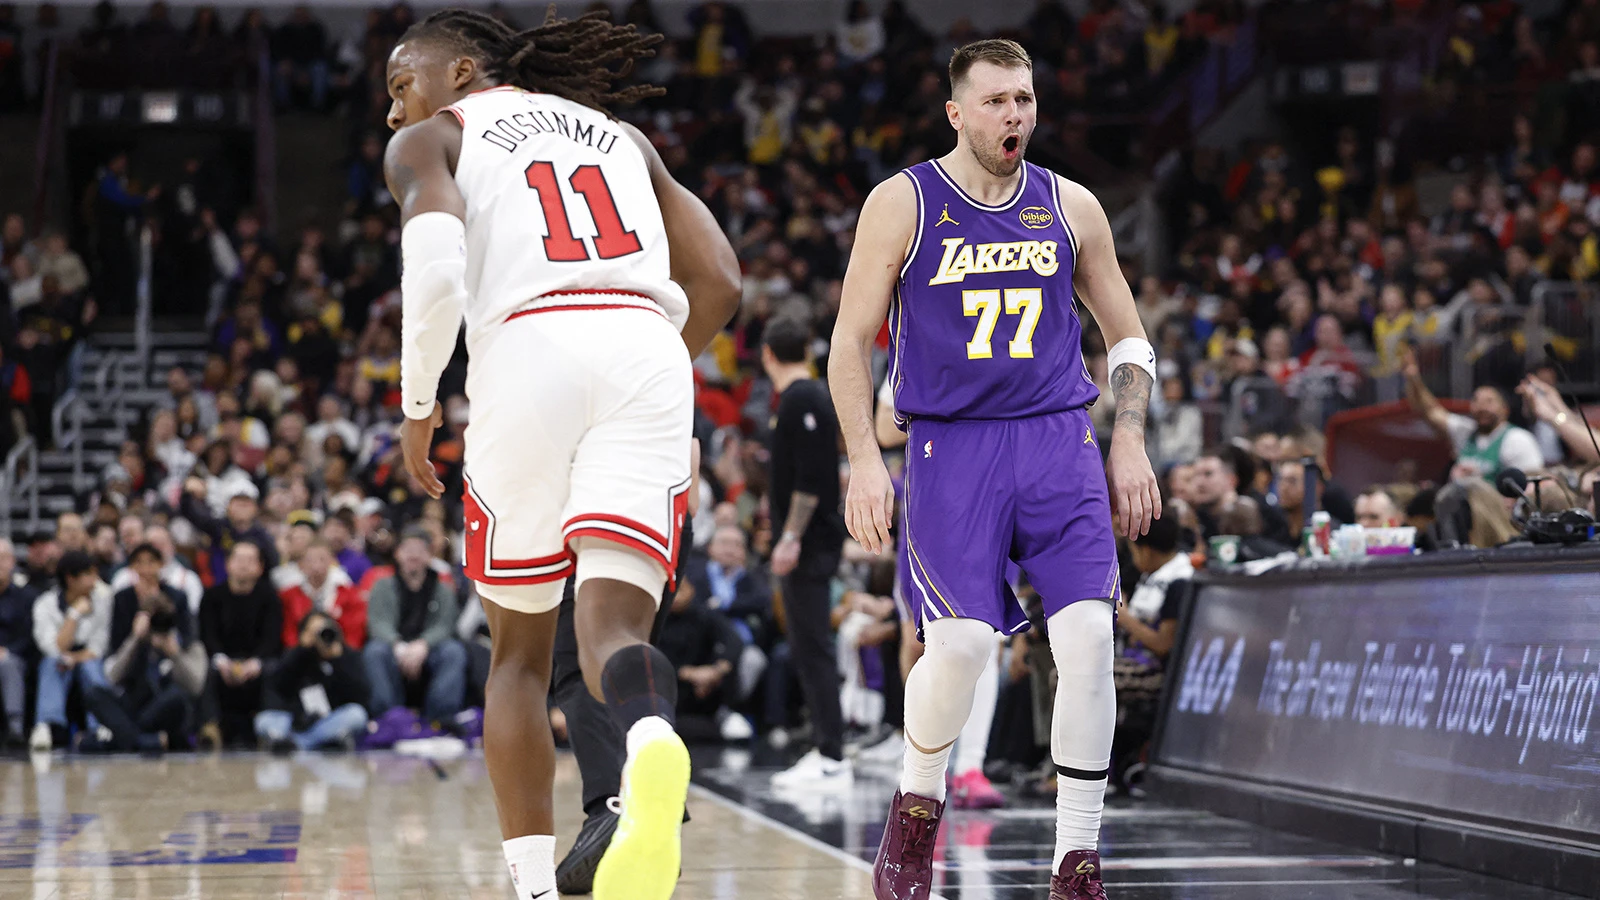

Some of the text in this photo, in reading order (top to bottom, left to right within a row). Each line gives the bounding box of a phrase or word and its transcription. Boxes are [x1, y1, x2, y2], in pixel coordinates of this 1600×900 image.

[482, 111, 619, 154] DOSUNMU
[524, 160, 643, 262] 11
[1022, 213, 1051, 222] bibigo
[928, 237, 1059, 286] LAKERS
[962, 288, 1043, 360] 77
[1257, 640, 1294, 716] The
[1352, 642, 1439, 730] Telluride
